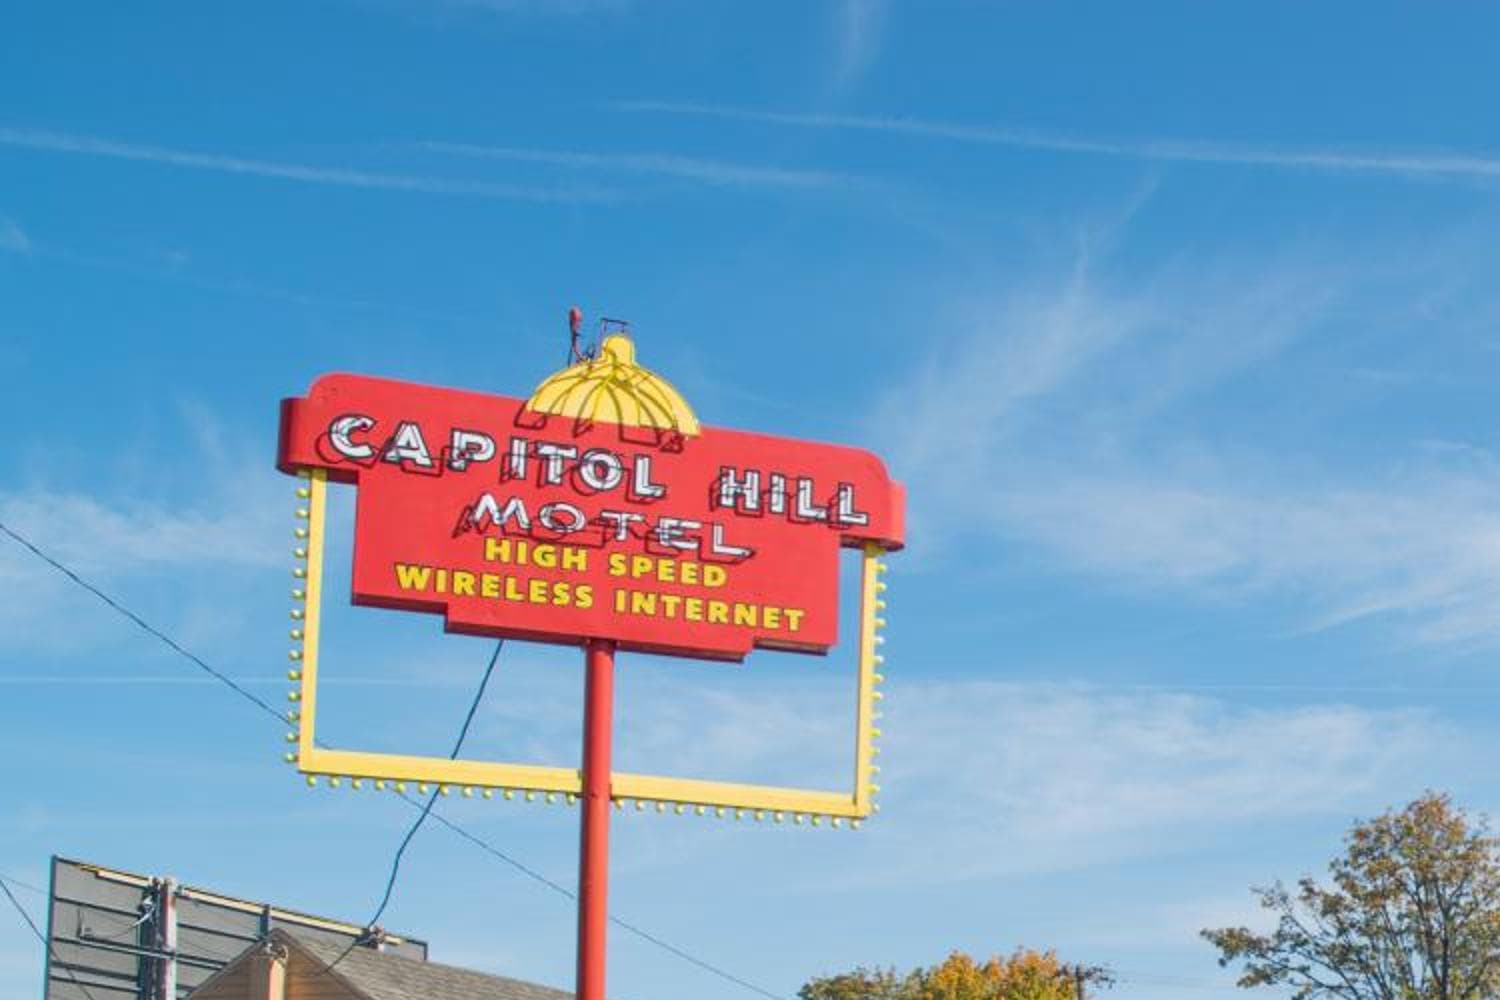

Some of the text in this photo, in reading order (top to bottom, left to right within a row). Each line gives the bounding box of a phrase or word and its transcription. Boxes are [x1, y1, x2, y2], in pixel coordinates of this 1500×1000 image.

[327, 414, 871, 528] CAPITOL HILL
[472, 492, 757, 559] MOTEL
[394, 562, 806, 632] WIRELESS INTERNET
[483, 538, 729, 588] HIGH SPEED
